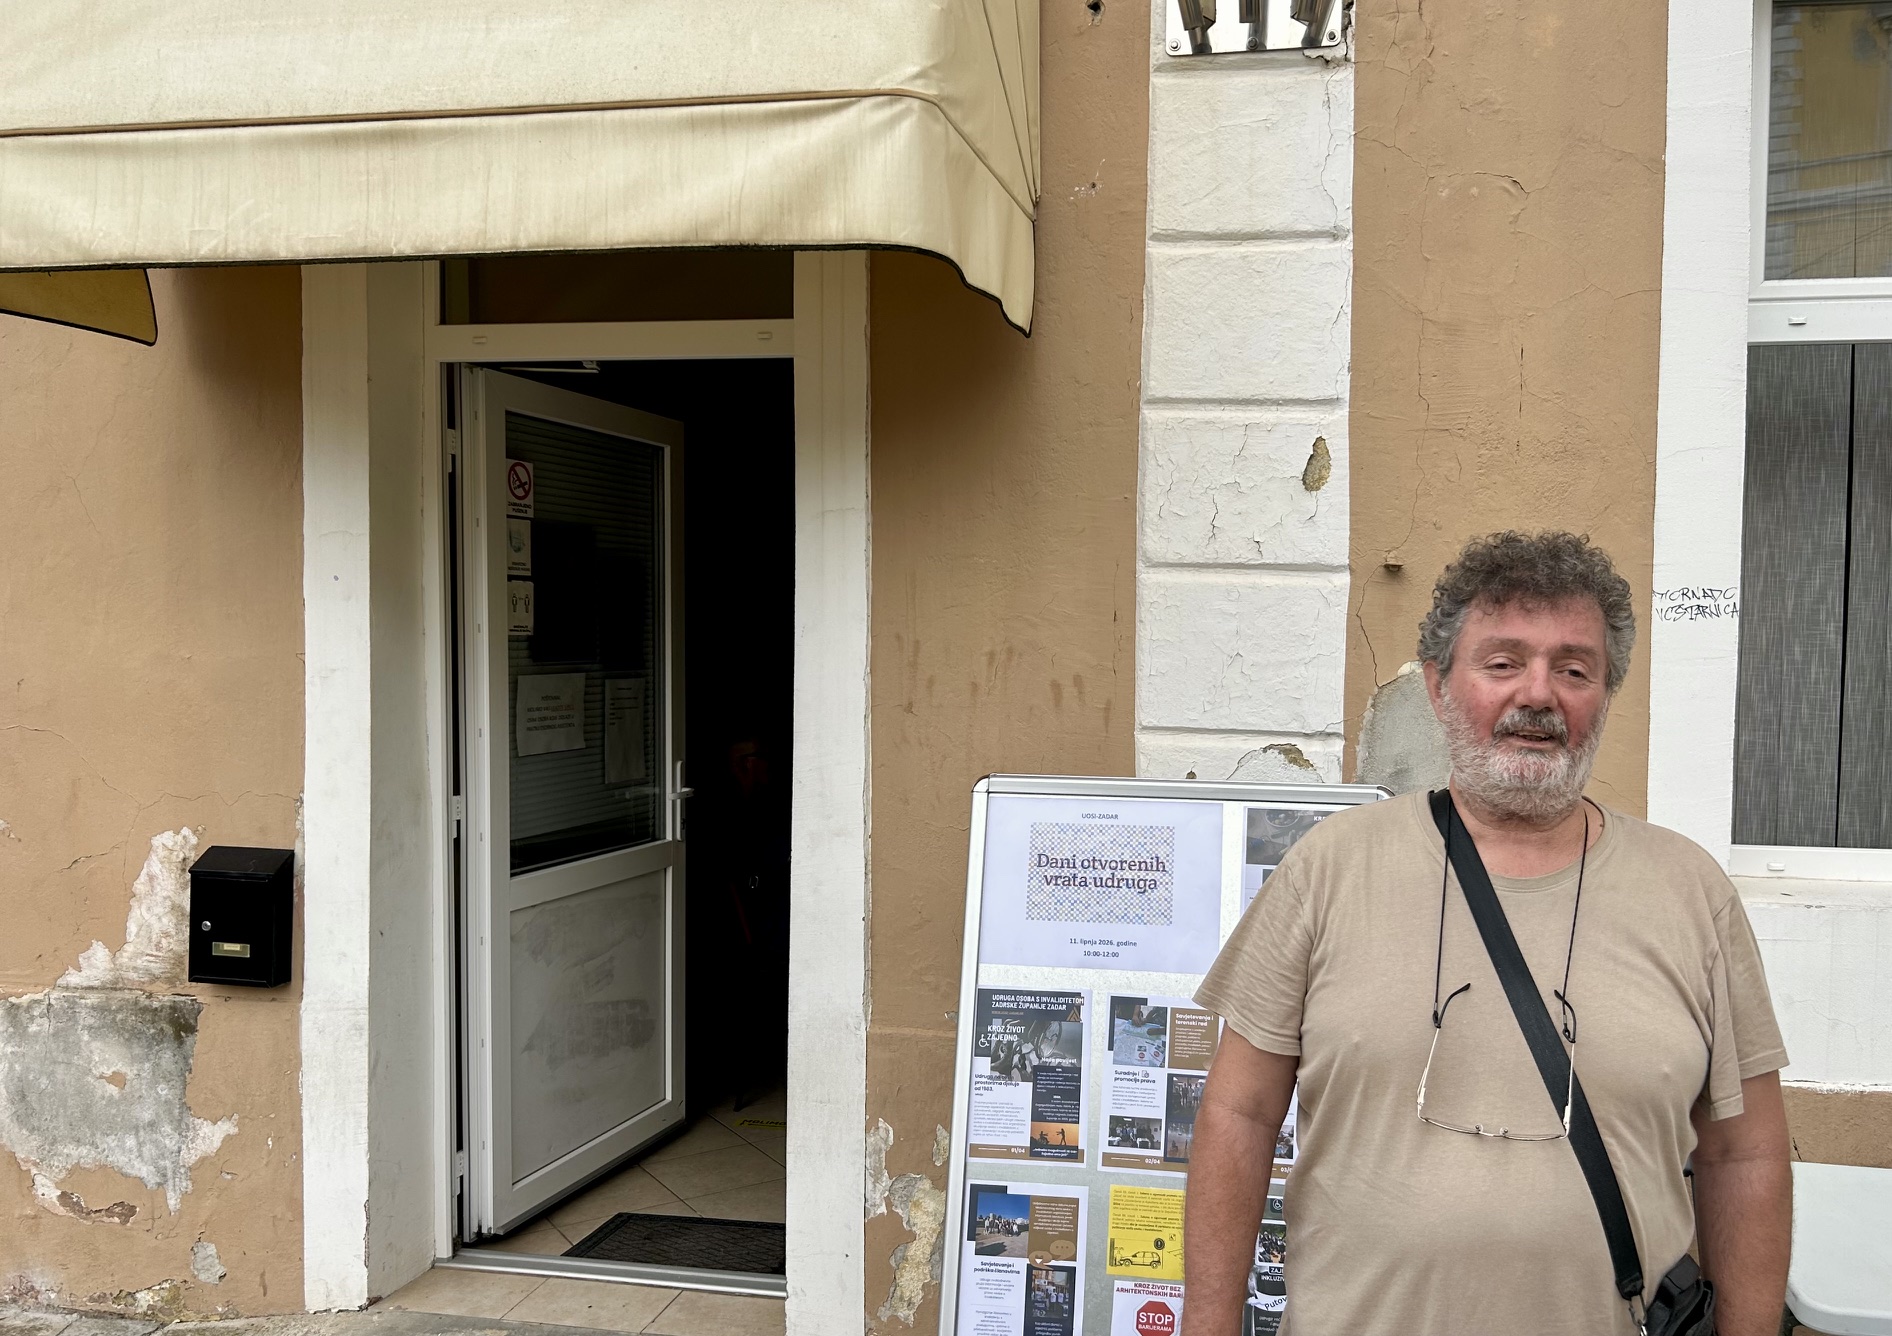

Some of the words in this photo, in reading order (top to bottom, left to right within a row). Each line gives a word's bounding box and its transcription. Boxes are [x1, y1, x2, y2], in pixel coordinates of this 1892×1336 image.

[1081, 812, 1119, 820] UOSI-ZADAR
[1036, 853, 1077, 869] Dani
[1080, 856, 1167, 872] otvorenih
[1043, 873, 1088, 887] vrata
[1092, 873, 1158, 894] udruga
[1080, 938, 1097, 946] lipnja
[1098, 938, 1115, 946] 2026.
[1083, 950, 1120, 958] 10:00-12:00
[992, 994, 1014, 1002] UDRUGA
[1015, 995, 1035, 1003] OSOBA
[1040, 996, 1084, 1004] INVALIDITETOM
[991, 1001, 1018, 1009] ZADRSKE
[1018, 1001, 1046, 1010] ŽUPANIJE
[1046, 1003, 1067, 1011] ZADAR
[987, 1025, 1006, 1033] KROZ
[1005, 1023, 1026, 1034] ŽIVOT
[986, 1033, 1019, 1042] ZAJEDNO
[1144, 1157, 1160, 1165] 02/04
[1133, 1282, 1150, 1290] KROZ
[1115, 1286, 1168, 1297] ARHITEKTONSKIH
[1138, 1312, 1173, 1325] STOP
[1138, 1323, 1172, 1332] BARIJERAMA
